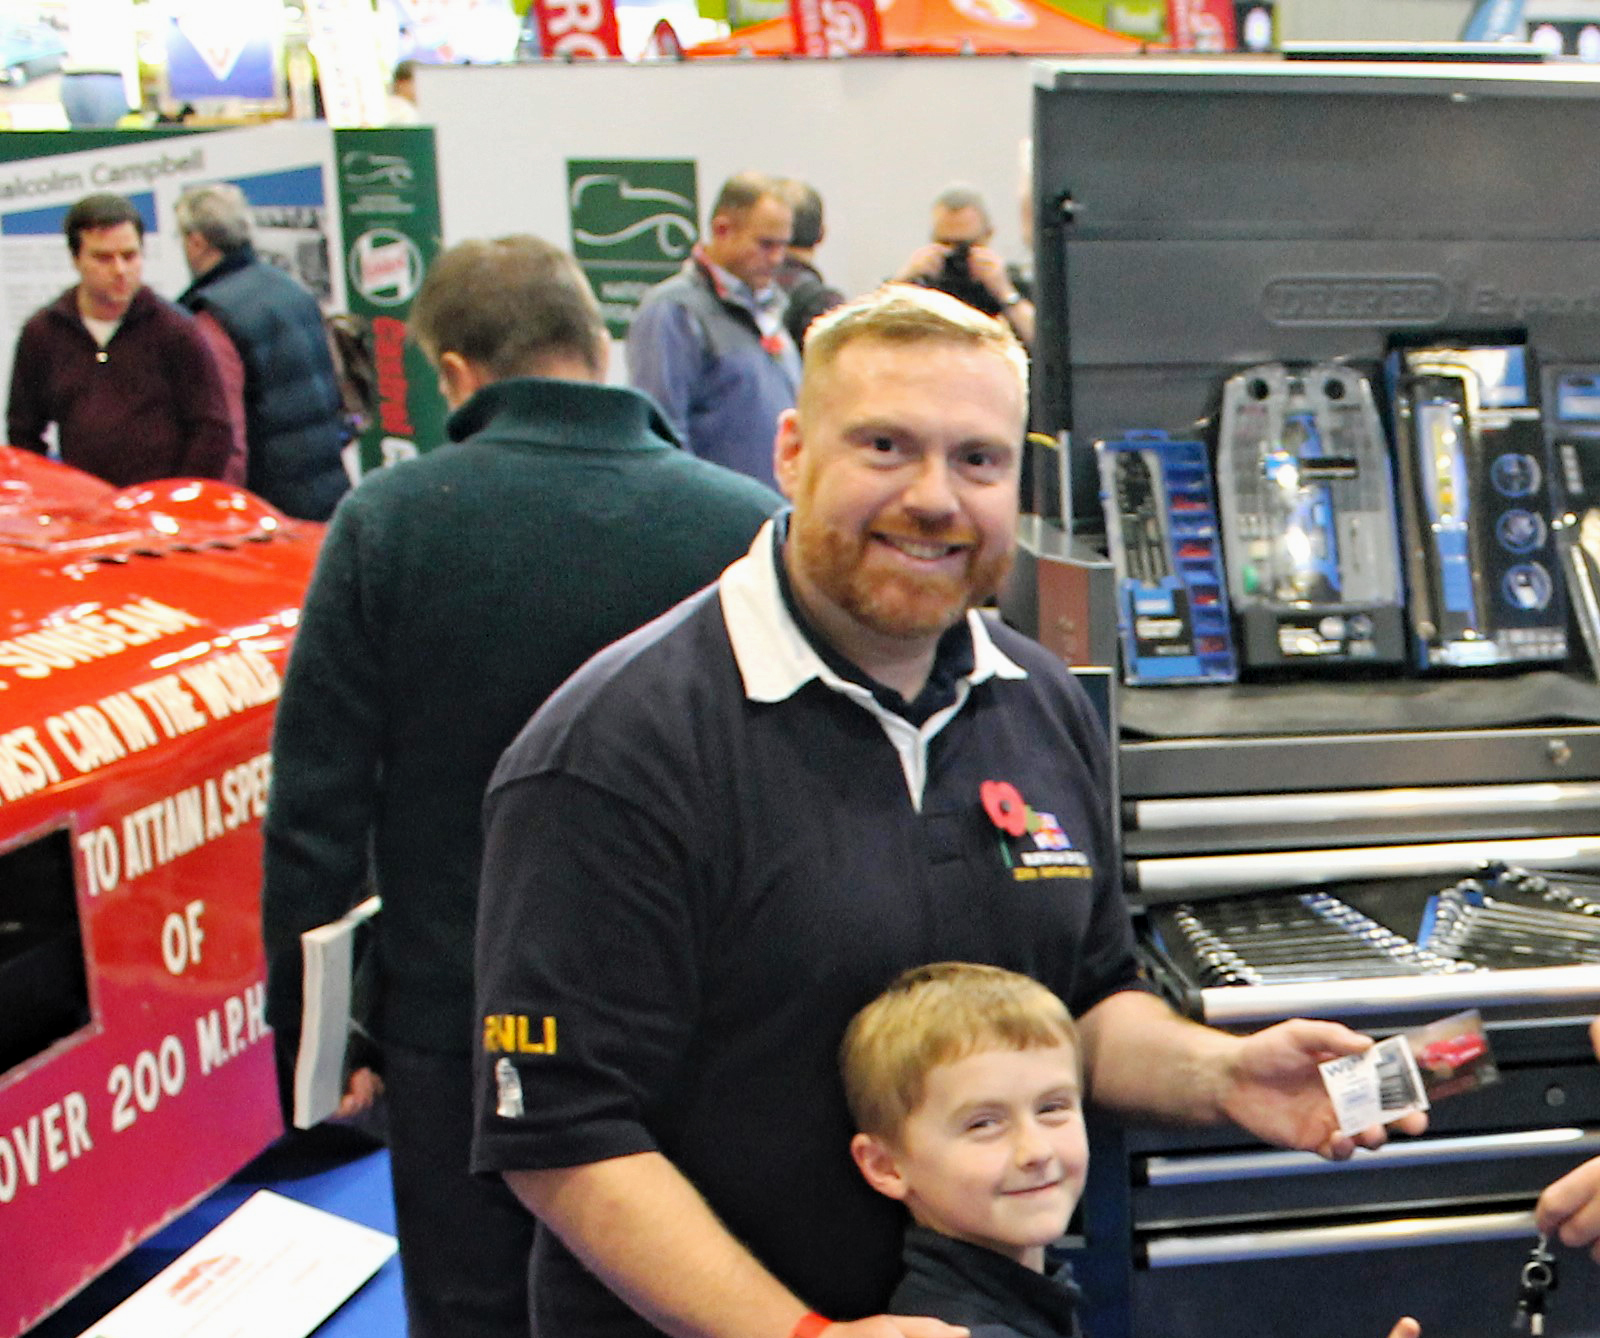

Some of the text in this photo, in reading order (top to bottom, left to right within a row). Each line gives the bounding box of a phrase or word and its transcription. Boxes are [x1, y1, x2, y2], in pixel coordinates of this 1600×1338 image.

[90, 148, 205, 186] Campbell
[45, 705, 127, 773] CAR
[97, 691, 159, 752] IN
[130, 674, 208, 738] THE
[78, 825, 119, 897] TO
[122, 786, 204, 881] ATTAIN
[204, 778, 224, 841] A
[161, 900, 205, 975] OF
[0, 1091, 93, 1204] OVER
[107, 1035, 187, 1134] 200
